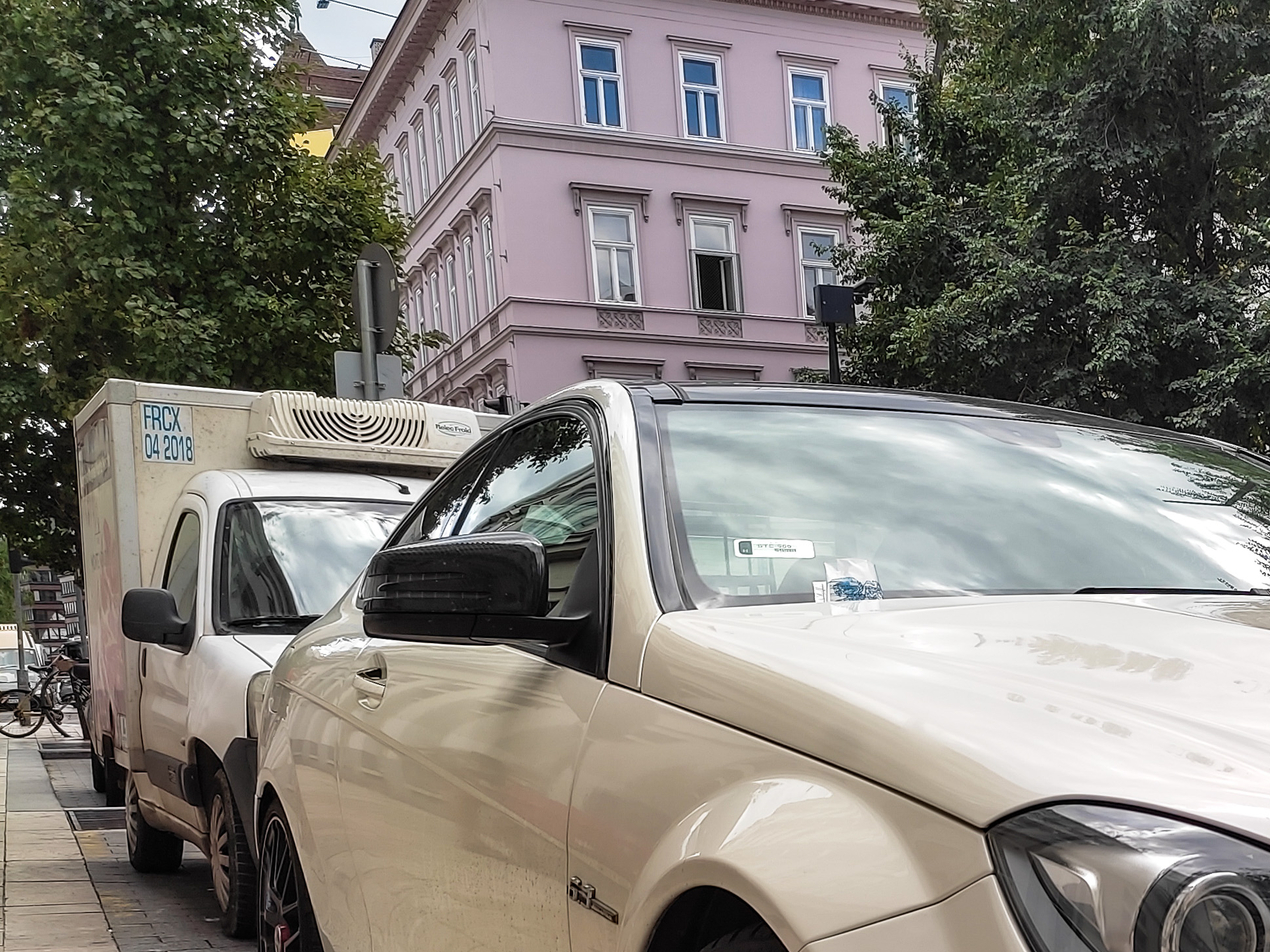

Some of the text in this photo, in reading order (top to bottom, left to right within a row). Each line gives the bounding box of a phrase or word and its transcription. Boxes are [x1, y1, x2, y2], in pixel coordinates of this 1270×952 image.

[143, 404, 182, 432] FRCX
[145, 433, 193, 462] 04 2018
